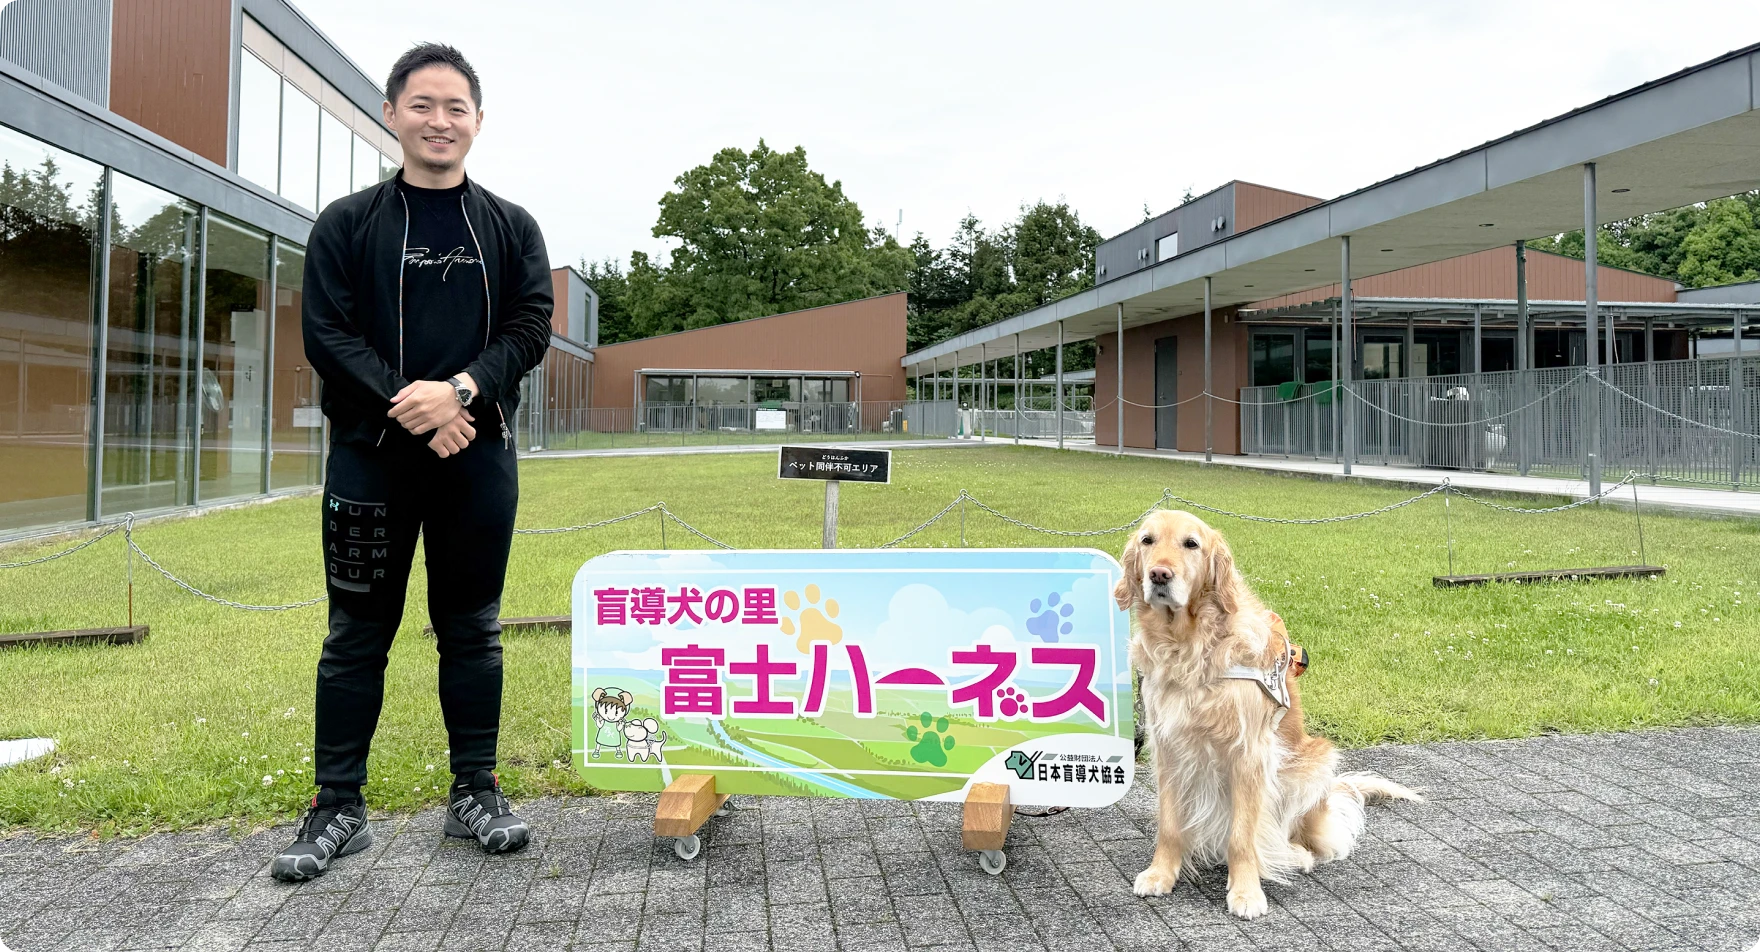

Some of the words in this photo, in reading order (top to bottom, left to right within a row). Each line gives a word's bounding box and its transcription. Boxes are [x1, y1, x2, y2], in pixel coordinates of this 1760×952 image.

[788, 461, 878, 473] ペット同伴不可エリア
[594, 587, 778, 625] 盲導犬の里
[661, 643, 1105, 723] 富士ハーネス
[1059, 753, 1104, 763] 公益財団法人
[1038, 763, 1125, 784] 日本盲導犬協会
